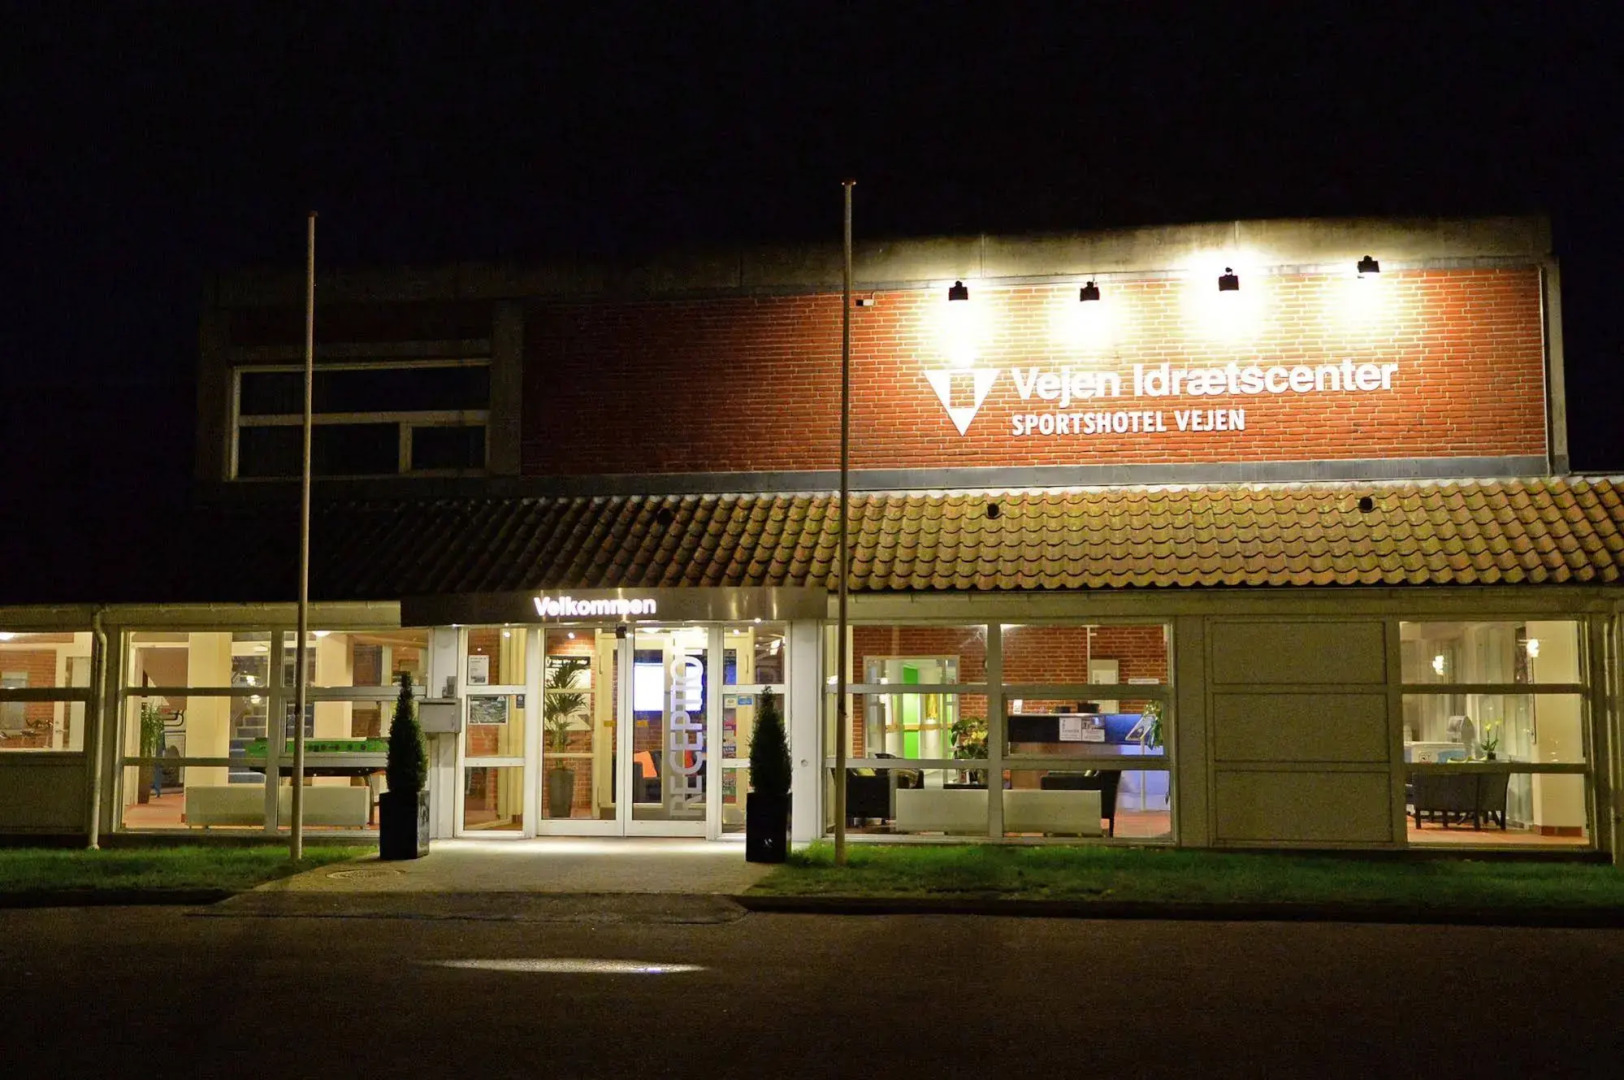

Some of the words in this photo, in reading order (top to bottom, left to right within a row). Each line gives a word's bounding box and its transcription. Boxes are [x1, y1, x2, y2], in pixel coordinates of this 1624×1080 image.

[1011, 366, 1121, 408] Vejen
[1133, 358, 1398, 397] Idrætscenter
[1012, 411, 1167, 436] SPORTSHOTEL
[1174, 409, 1245, 432] VEJEN
[533, 596, 657, 616] Velkommen
